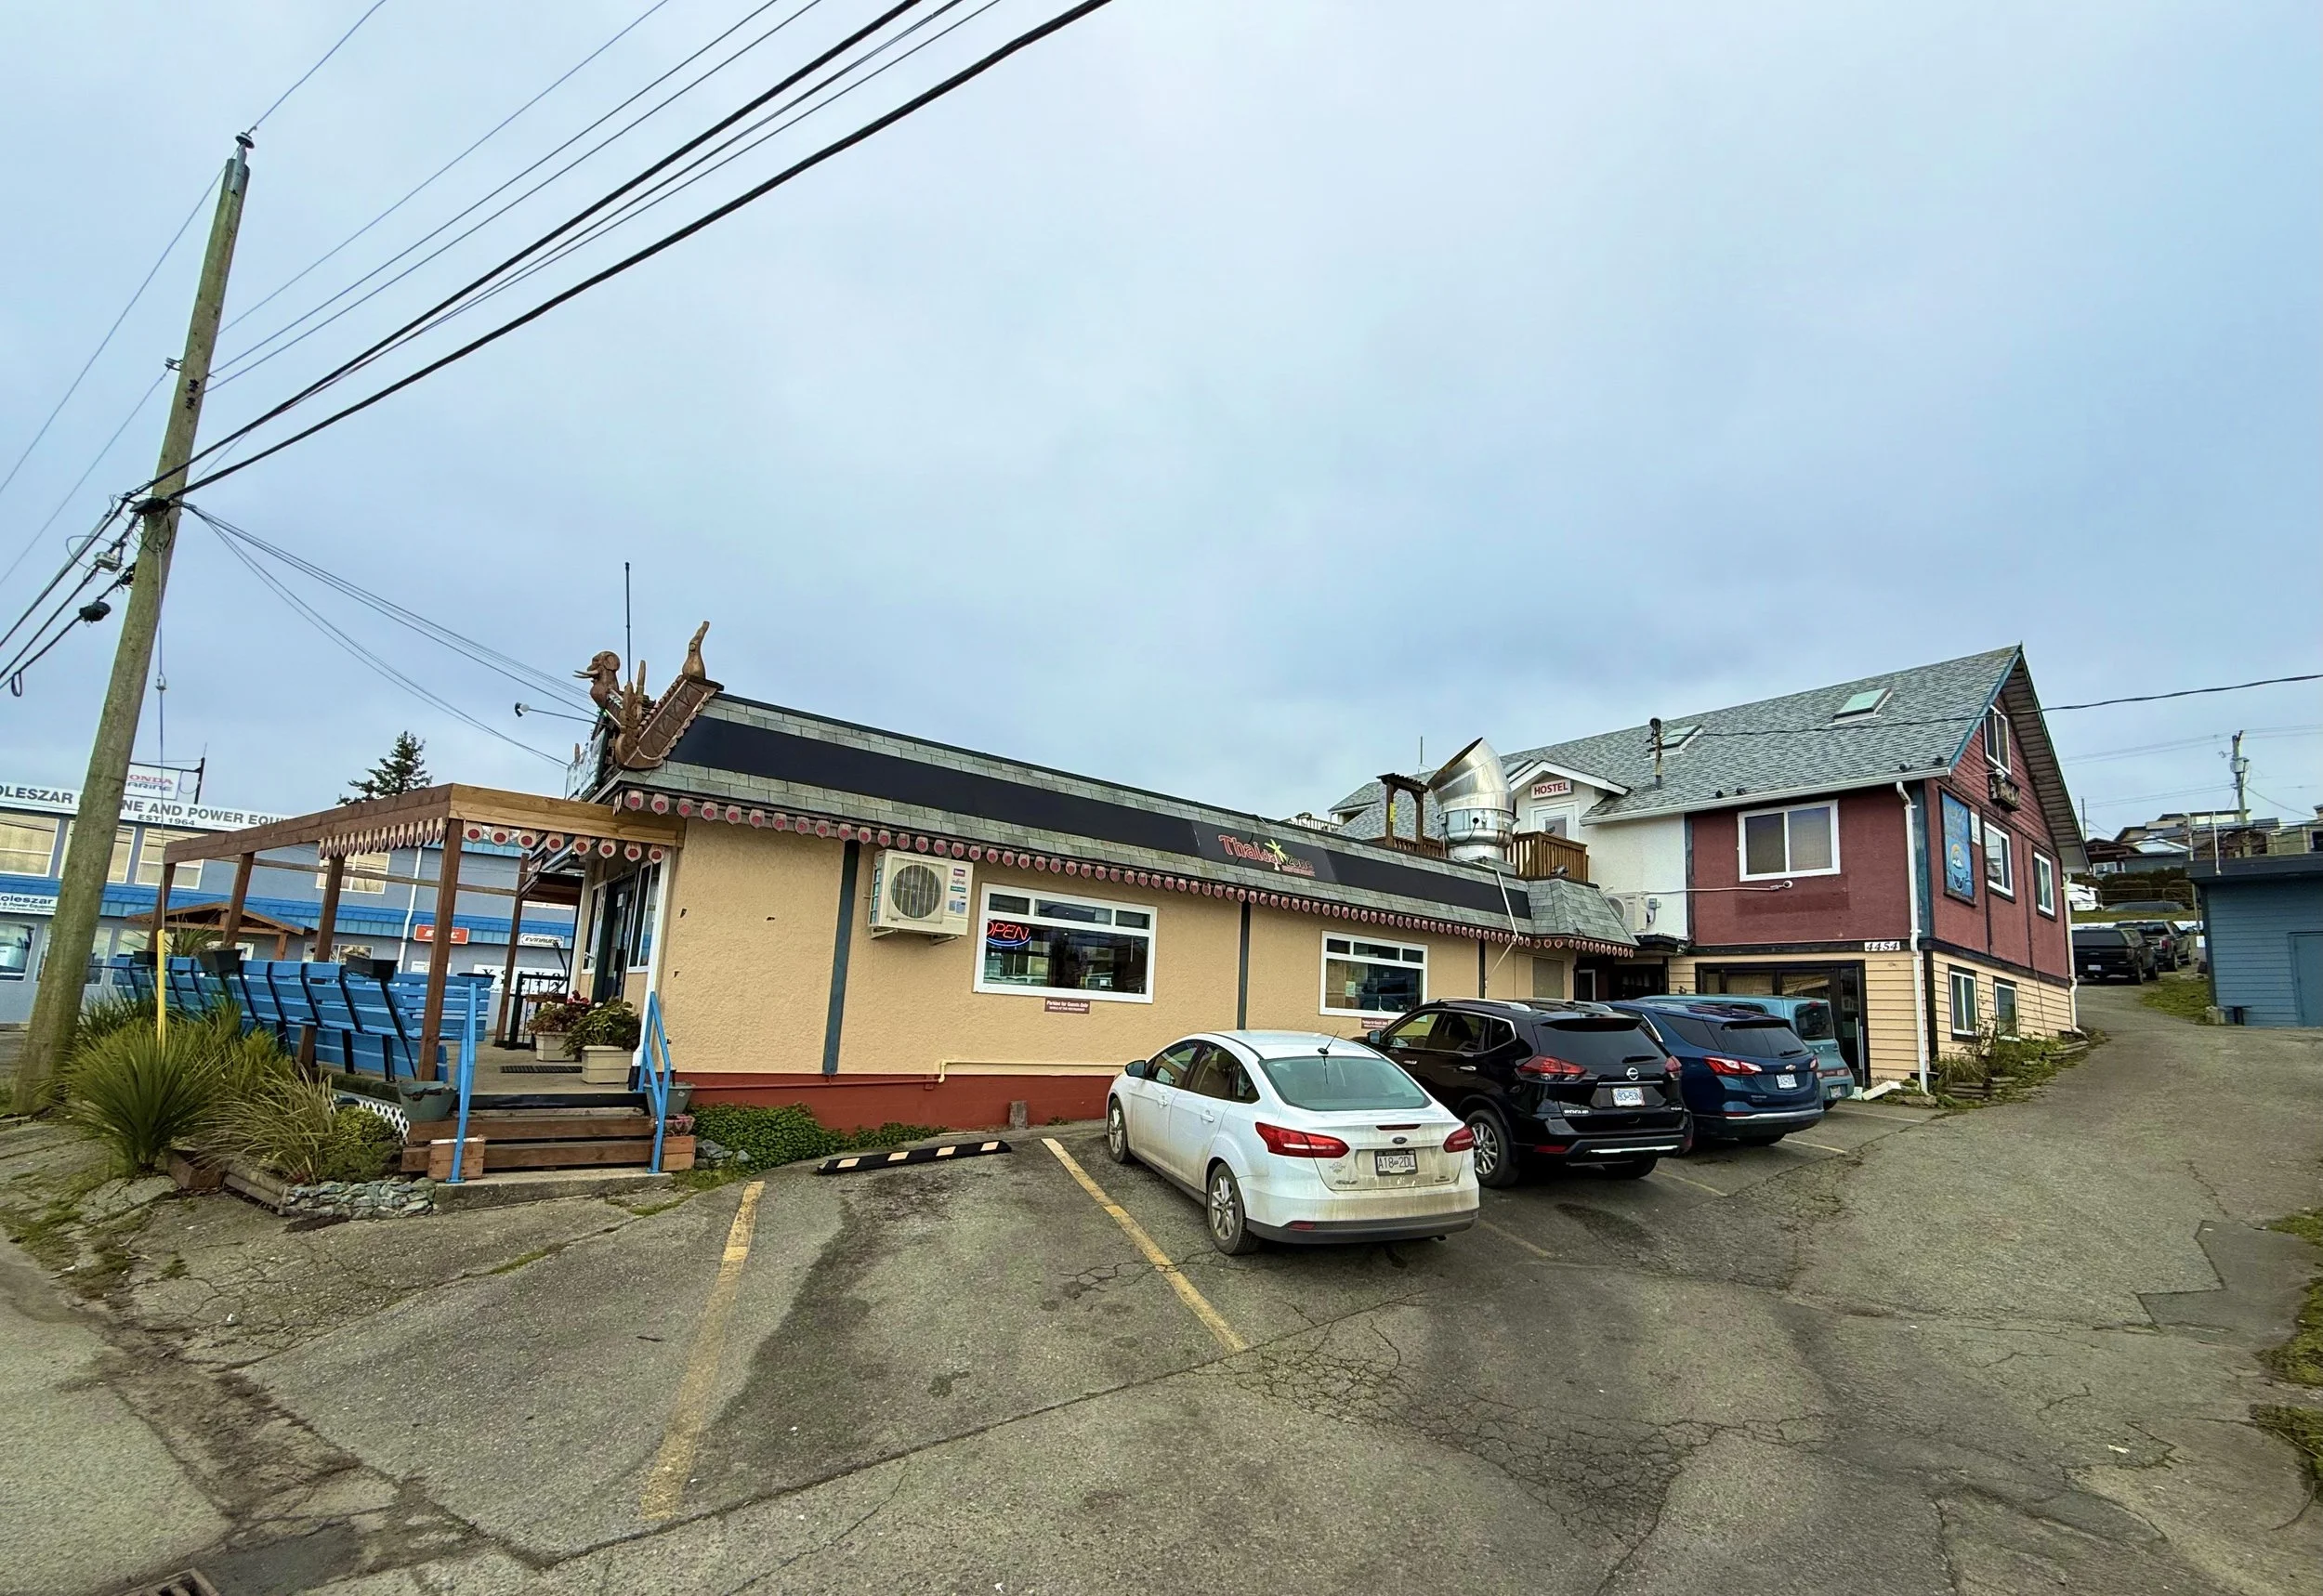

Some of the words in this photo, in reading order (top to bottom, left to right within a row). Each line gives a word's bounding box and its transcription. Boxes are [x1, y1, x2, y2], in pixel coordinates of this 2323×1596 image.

[1534, 782, 1568, 795] HOSTEL
[148, 803, 183, 817] AND
[187, 807, 243, 824] POWER
[168, 818, 195, 827] 1964
[1867, 942, 1898, 952] 4454
